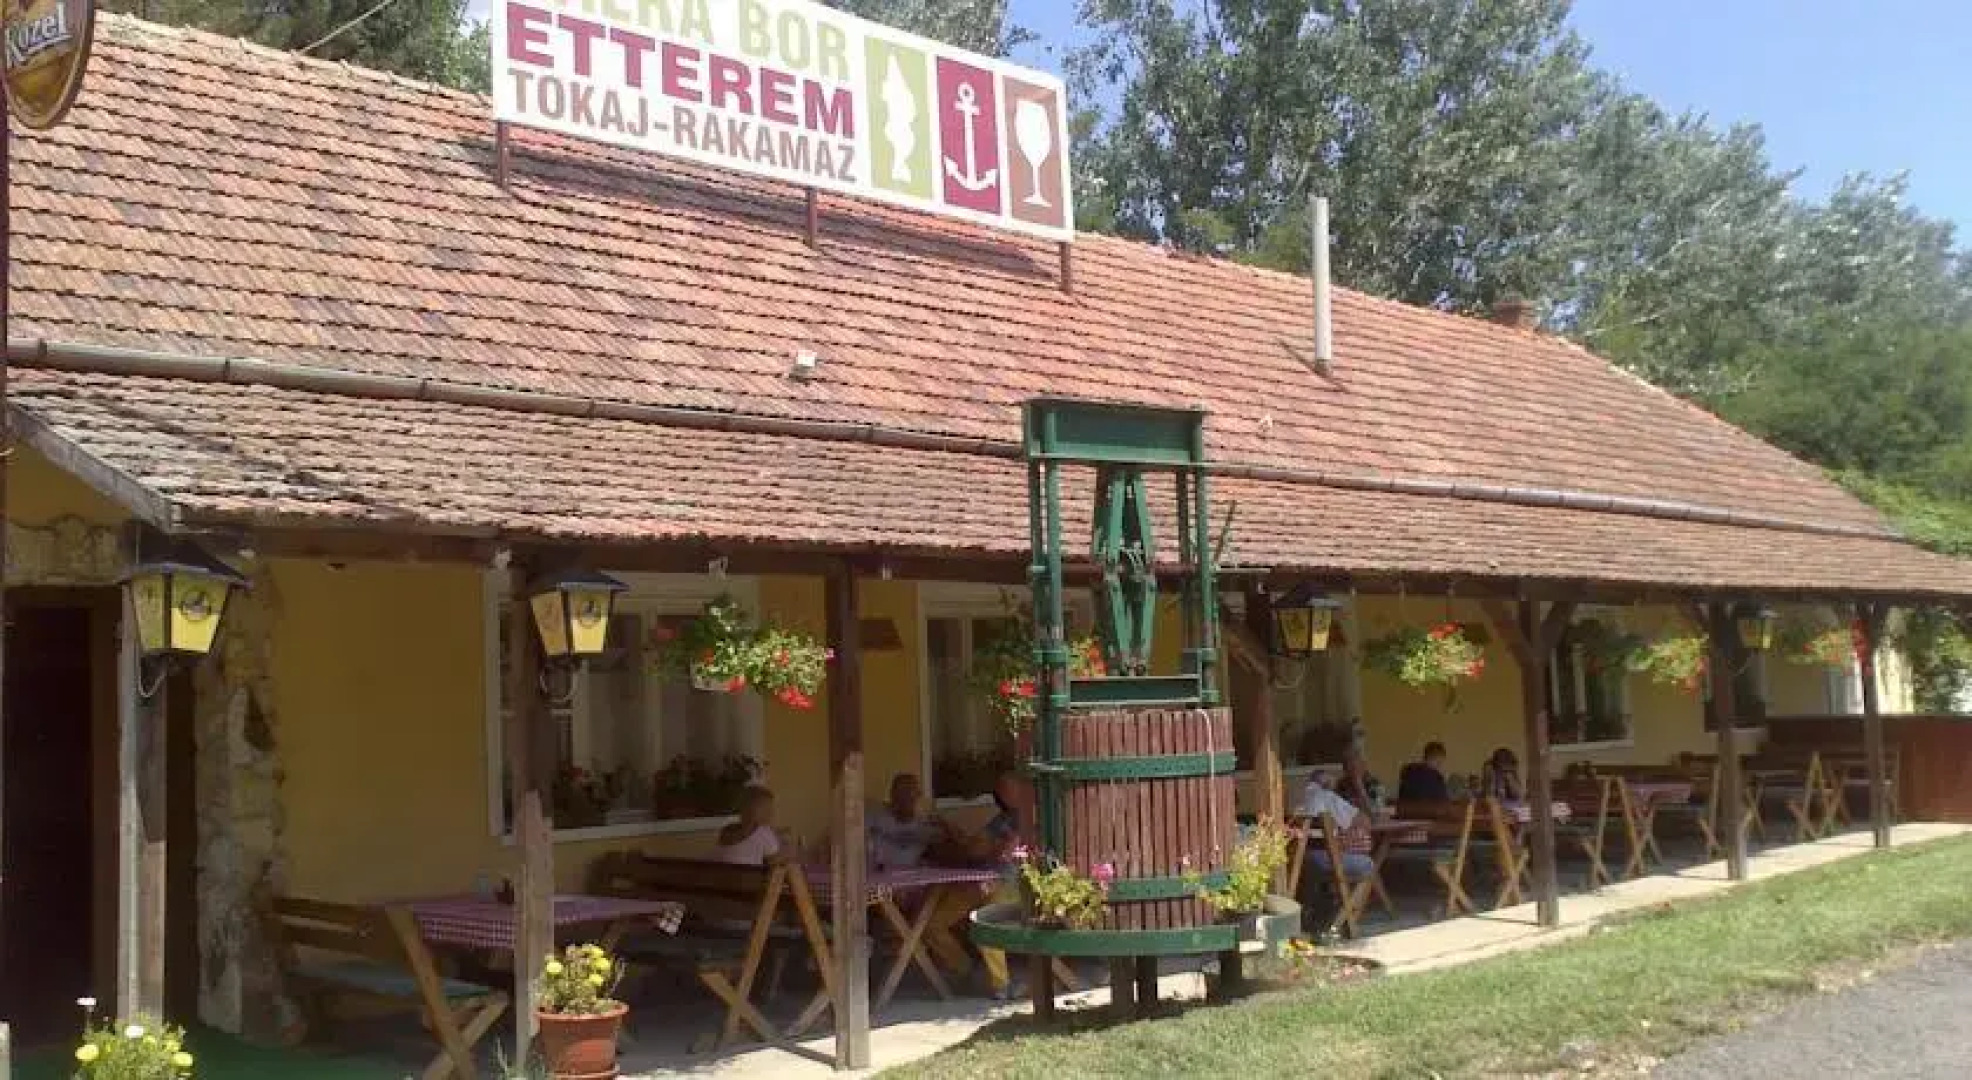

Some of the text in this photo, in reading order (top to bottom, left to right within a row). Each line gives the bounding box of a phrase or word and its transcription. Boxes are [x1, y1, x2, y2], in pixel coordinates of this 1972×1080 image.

[507, 2, 854, 139] ETTEREM
[738, 0, 849, 80] BOR
[507, 67, 857, 182] TOKAJ-RAKAMAZ
